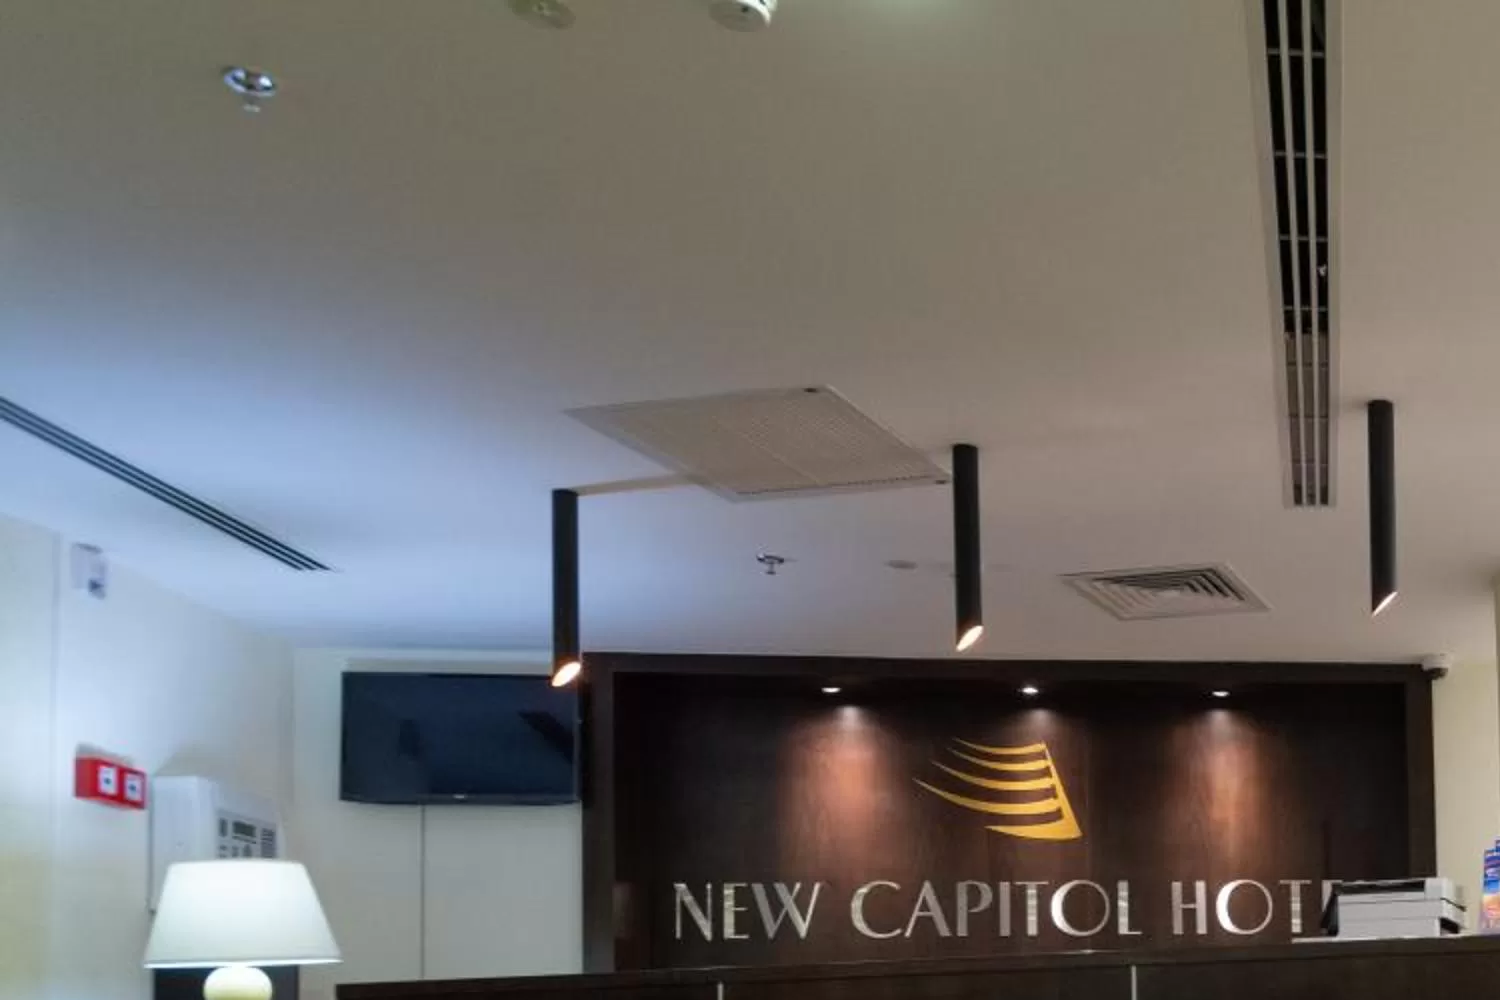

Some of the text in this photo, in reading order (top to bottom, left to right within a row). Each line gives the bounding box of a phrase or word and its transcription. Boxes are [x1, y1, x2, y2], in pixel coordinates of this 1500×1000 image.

[673, 878, 1343, 942] NEW CAPITOL HOT
